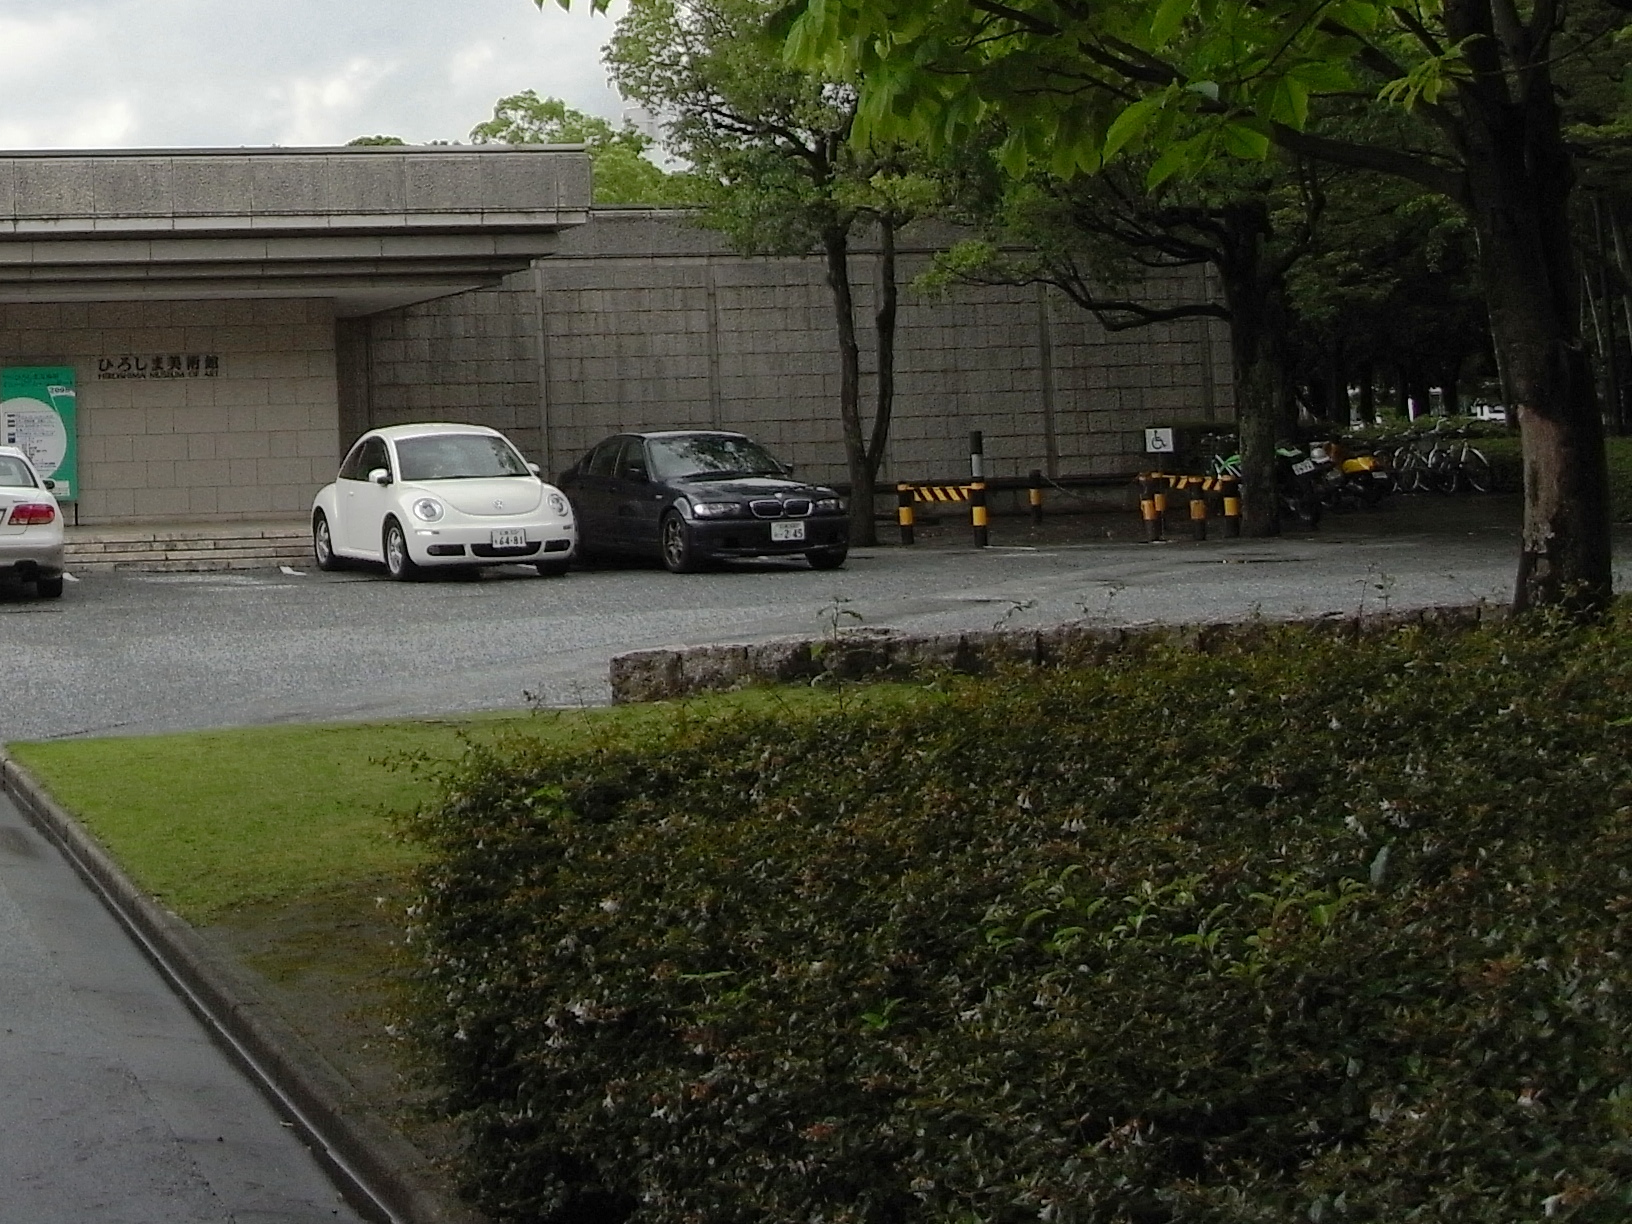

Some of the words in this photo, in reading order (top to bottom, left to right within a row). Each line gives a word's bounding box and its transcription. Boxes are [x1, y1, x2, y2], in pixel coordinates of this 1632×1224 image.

[98, 356, 219, 371] ひろしま美術館
